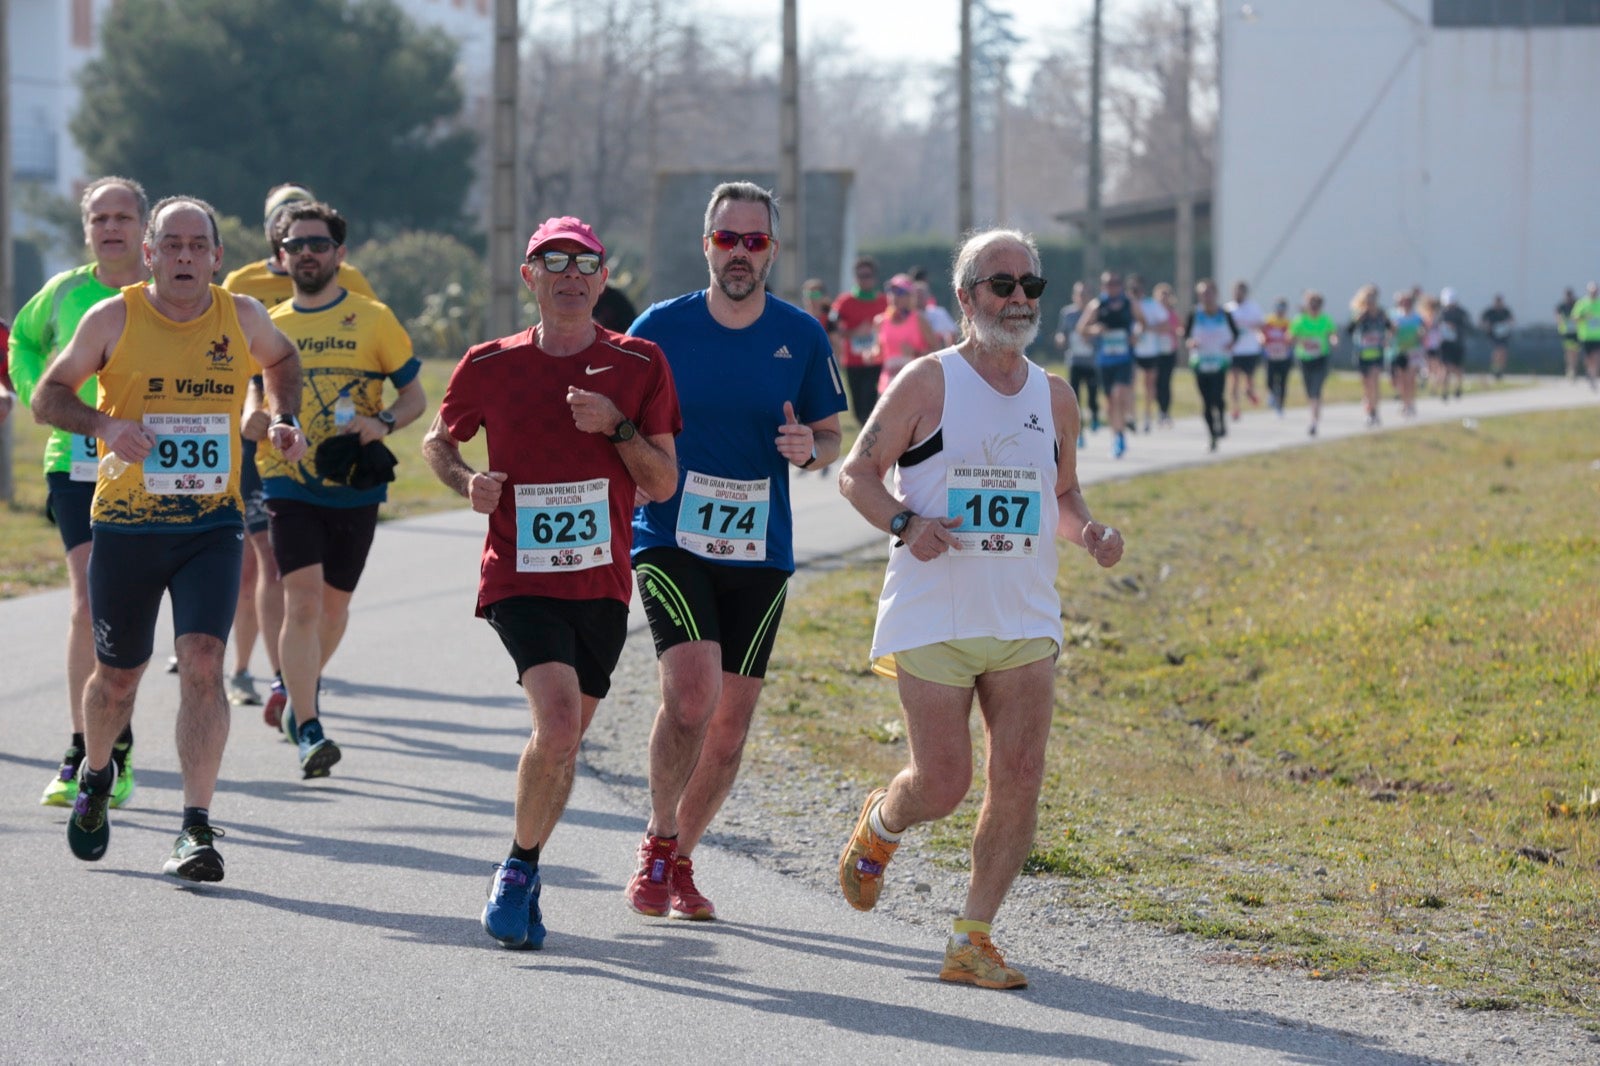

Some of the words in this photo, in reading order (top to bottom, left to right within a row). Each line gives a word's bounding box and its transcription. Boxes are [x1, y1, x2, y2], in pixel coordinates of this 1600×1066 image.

[297, 337, 357, 353] Vigilsa
[175, 379, 235, 397] Vigilsa
[165, 416, 181, 424] GRAN
[203, 416, 211, 424] DE
[158, 439, 219, 469] 936
[954, 468, 972, 478] XXXIII
[973, 468, 990, 478] GRAN
[991, 469, 1013, 479] PREMIO
[1014, 471, 1021, 480] DE
[537, 486, 554, 496] GRAN
[555, 484, 577, 495] PREMIO
[577, 484, 586, 493] DE
[709, 478, 725, 488] GRAN
[725, 481, 746, 492] PREMIO
[746, 482, 754, 492] DE
[698, 502, 756, 535] 174
[965, 494, 1030, 529] 167
[532, 509, 598, 544] 623
